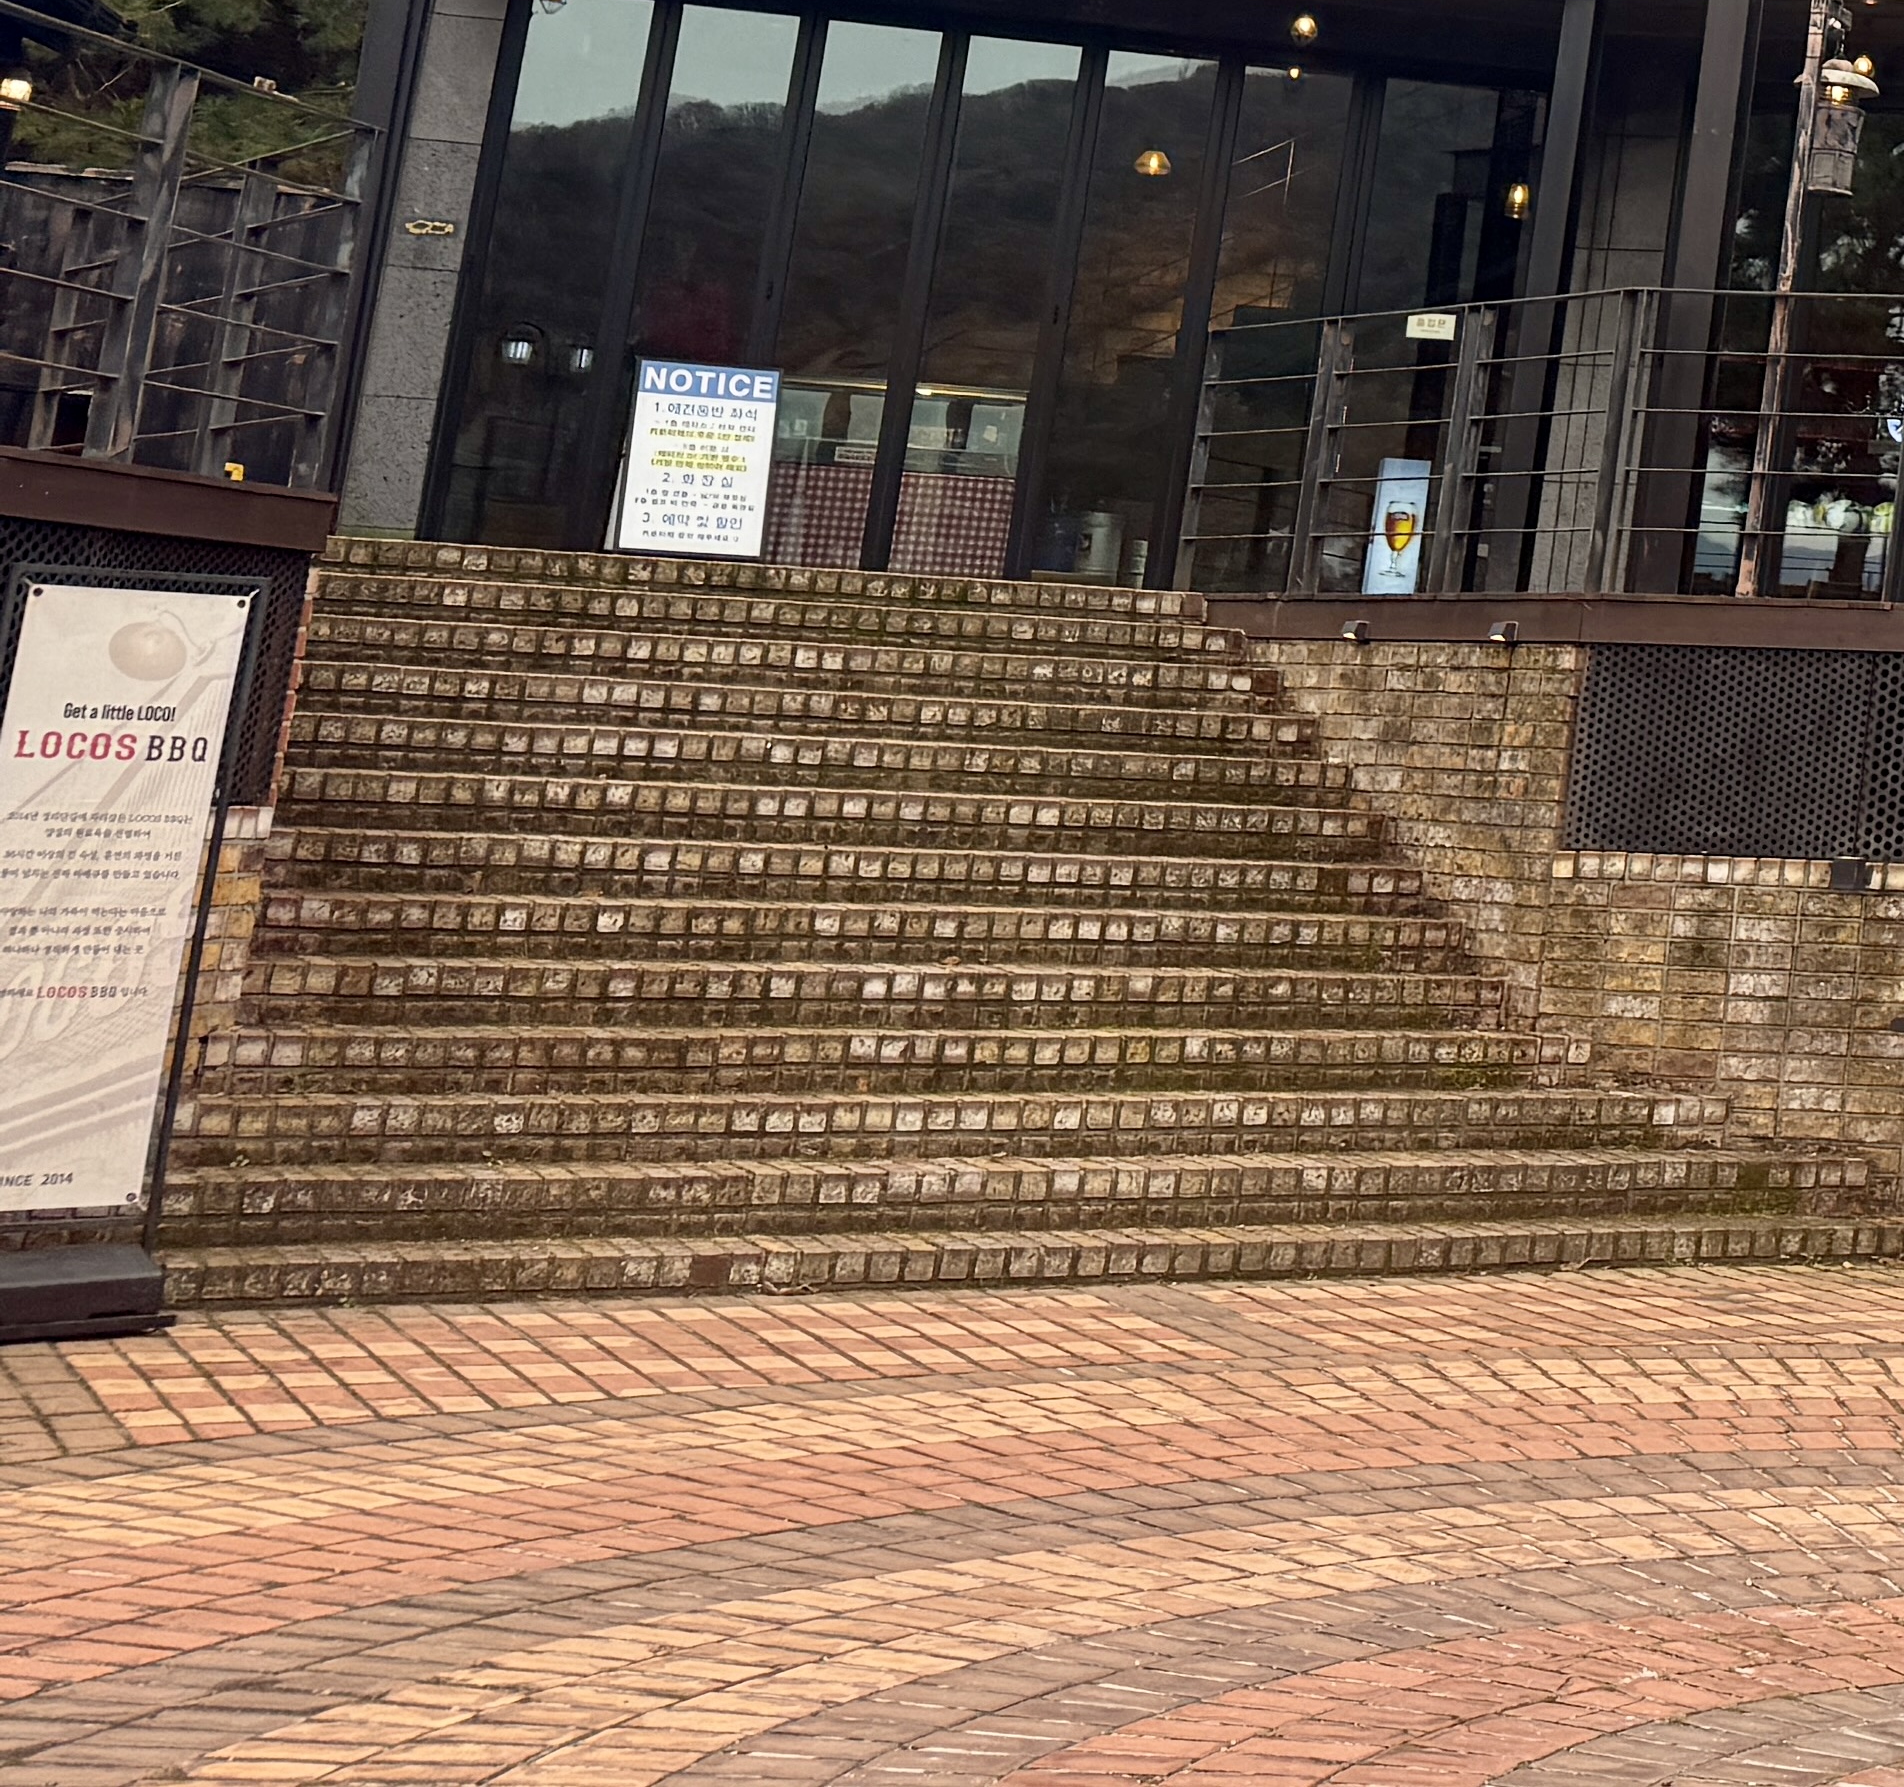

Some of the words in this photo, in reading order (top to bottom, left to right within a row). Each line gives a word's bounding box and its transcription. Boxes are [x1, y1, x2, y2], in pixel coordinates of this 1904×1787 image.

[644, 366, 773, 399] NOTICE
[64, 703, 87, 719] Get
[89, 708, 99, 720] a
[98, 704, 134, 721] little
[137, 706, 177, 723] LOCO!
[14, 729, 138, 761] LOCOS
[145, 734, 208, 763] BBQ
[36, 986, 88, 999] LOCOS
[90, 985, 118, 998] BBQ
[40, 1172, 74, 1186] 2014
